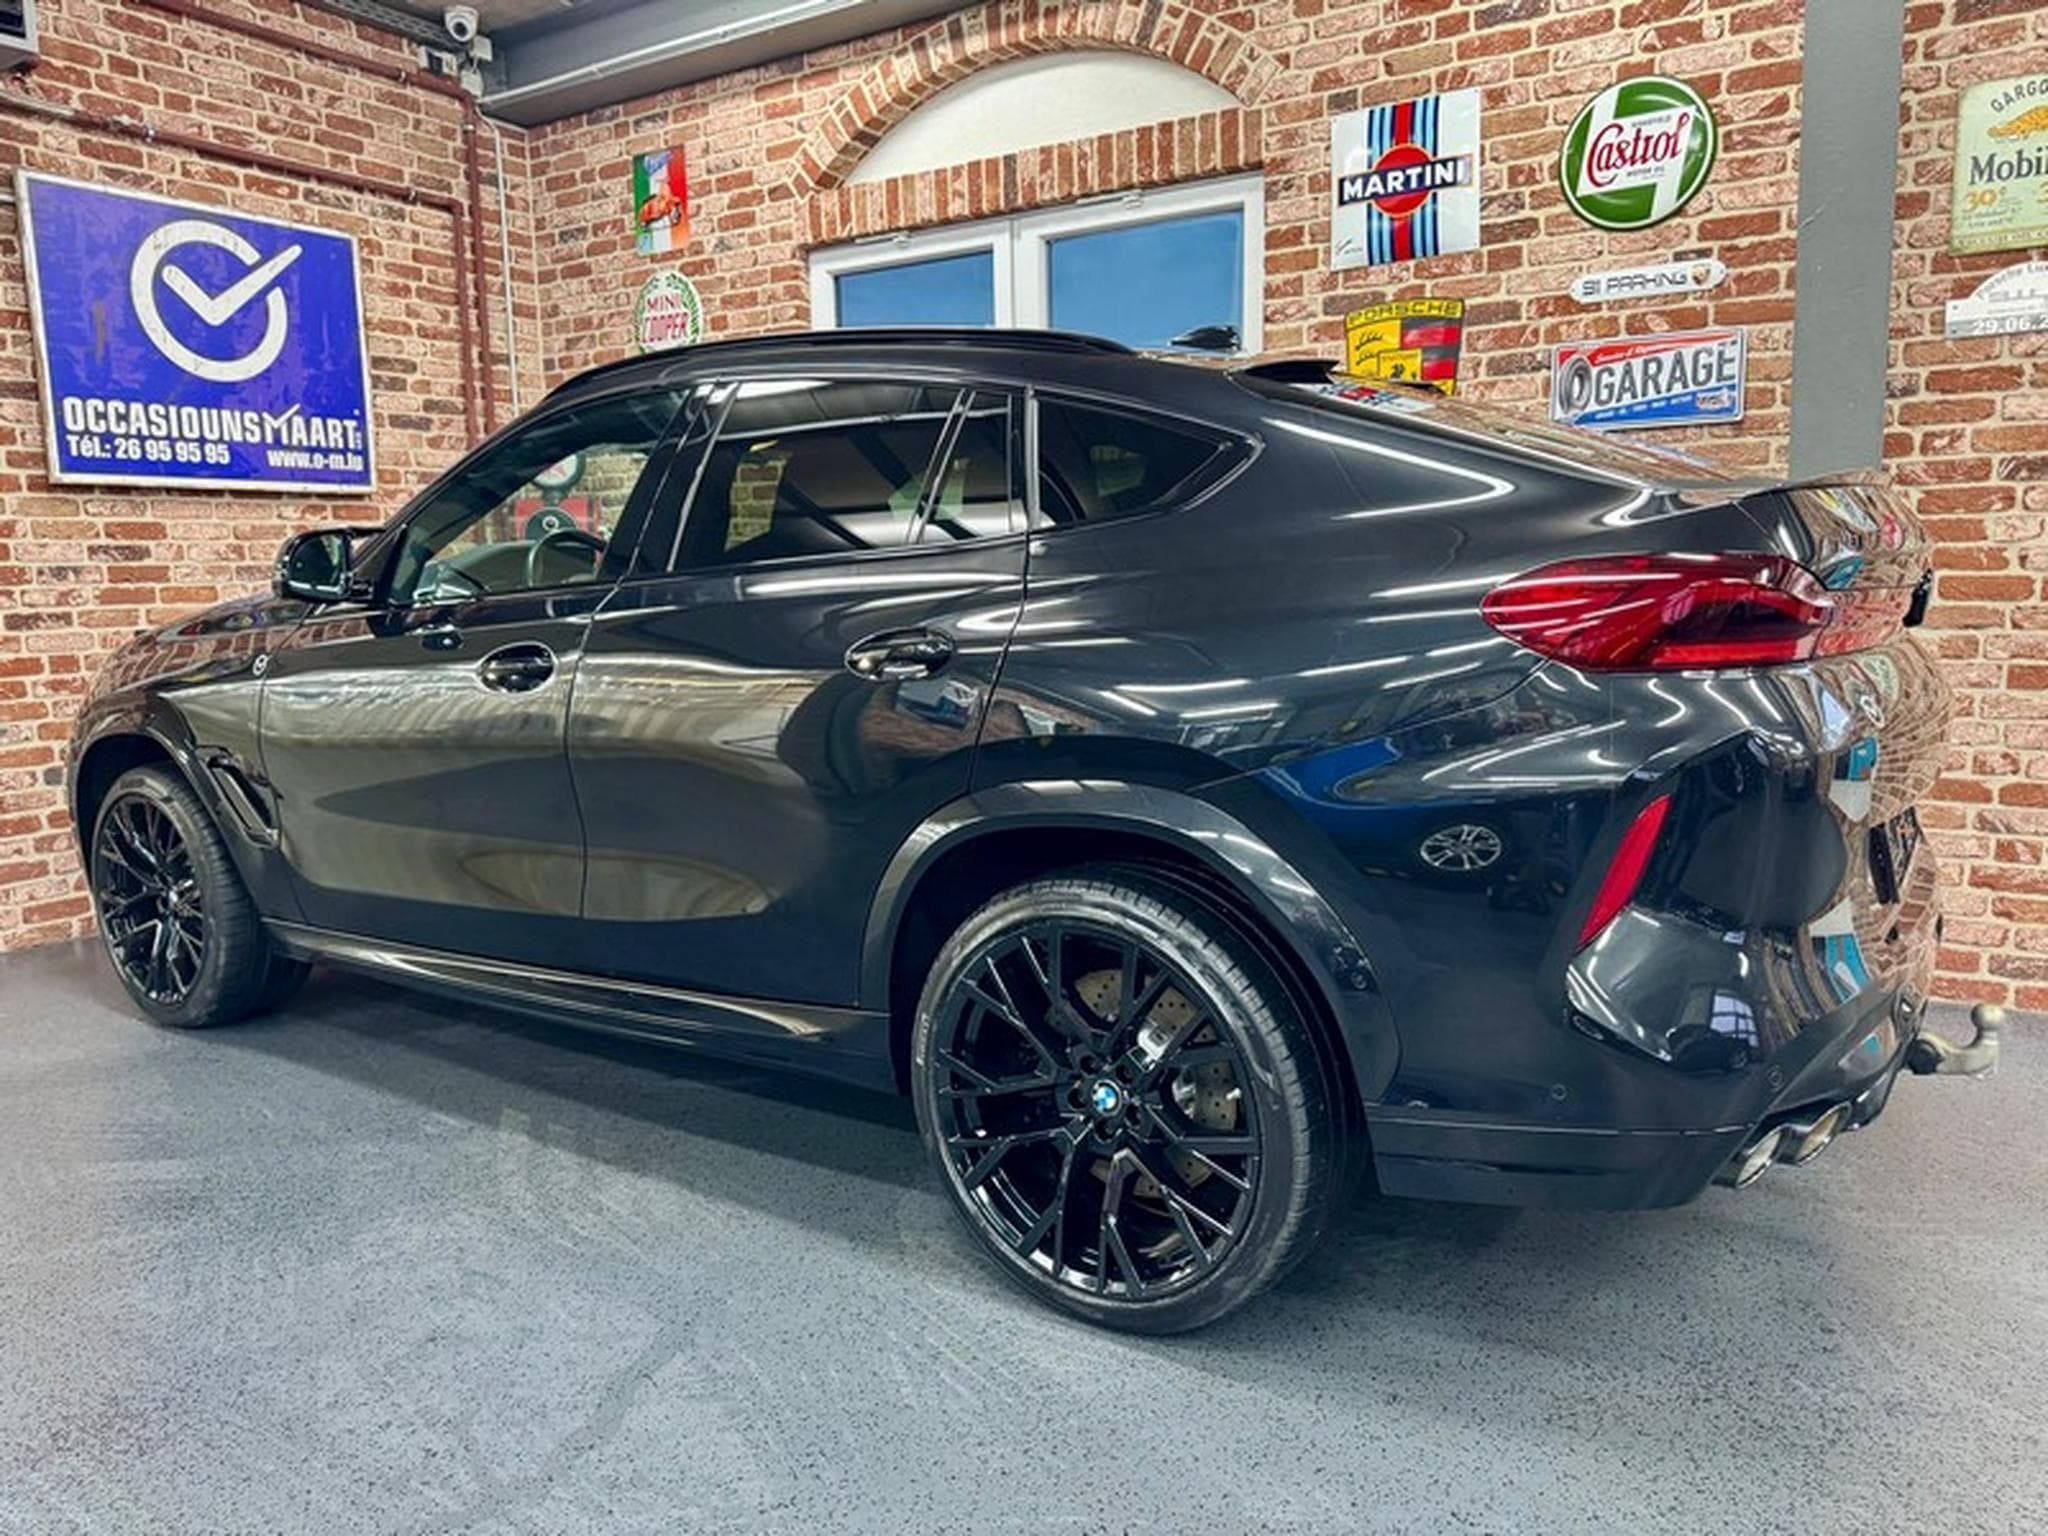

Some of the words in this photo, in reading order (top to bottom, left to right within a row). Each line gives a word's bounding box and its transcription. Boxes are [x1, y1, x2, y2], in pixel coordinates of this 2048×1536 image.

[1586, 112, 1690, 187] Castrol
[1343, 160, 1465, 201] MARTINI
[647, 292, 681, 312] MINI
[1348, 301, 1461, 327] PORSCHE
[1594, 340, 1739, 407] GARAGE
[63, 396, 357, 450] OCCASIOUNSMAART
[114, 437, 143, 460] 26
[145, 439, 173, 462] 95
[175, 441, 202, 464] 95
[204, 442, 231, 465] 95
[266, 450, 363, 471] www.o-m.lu
